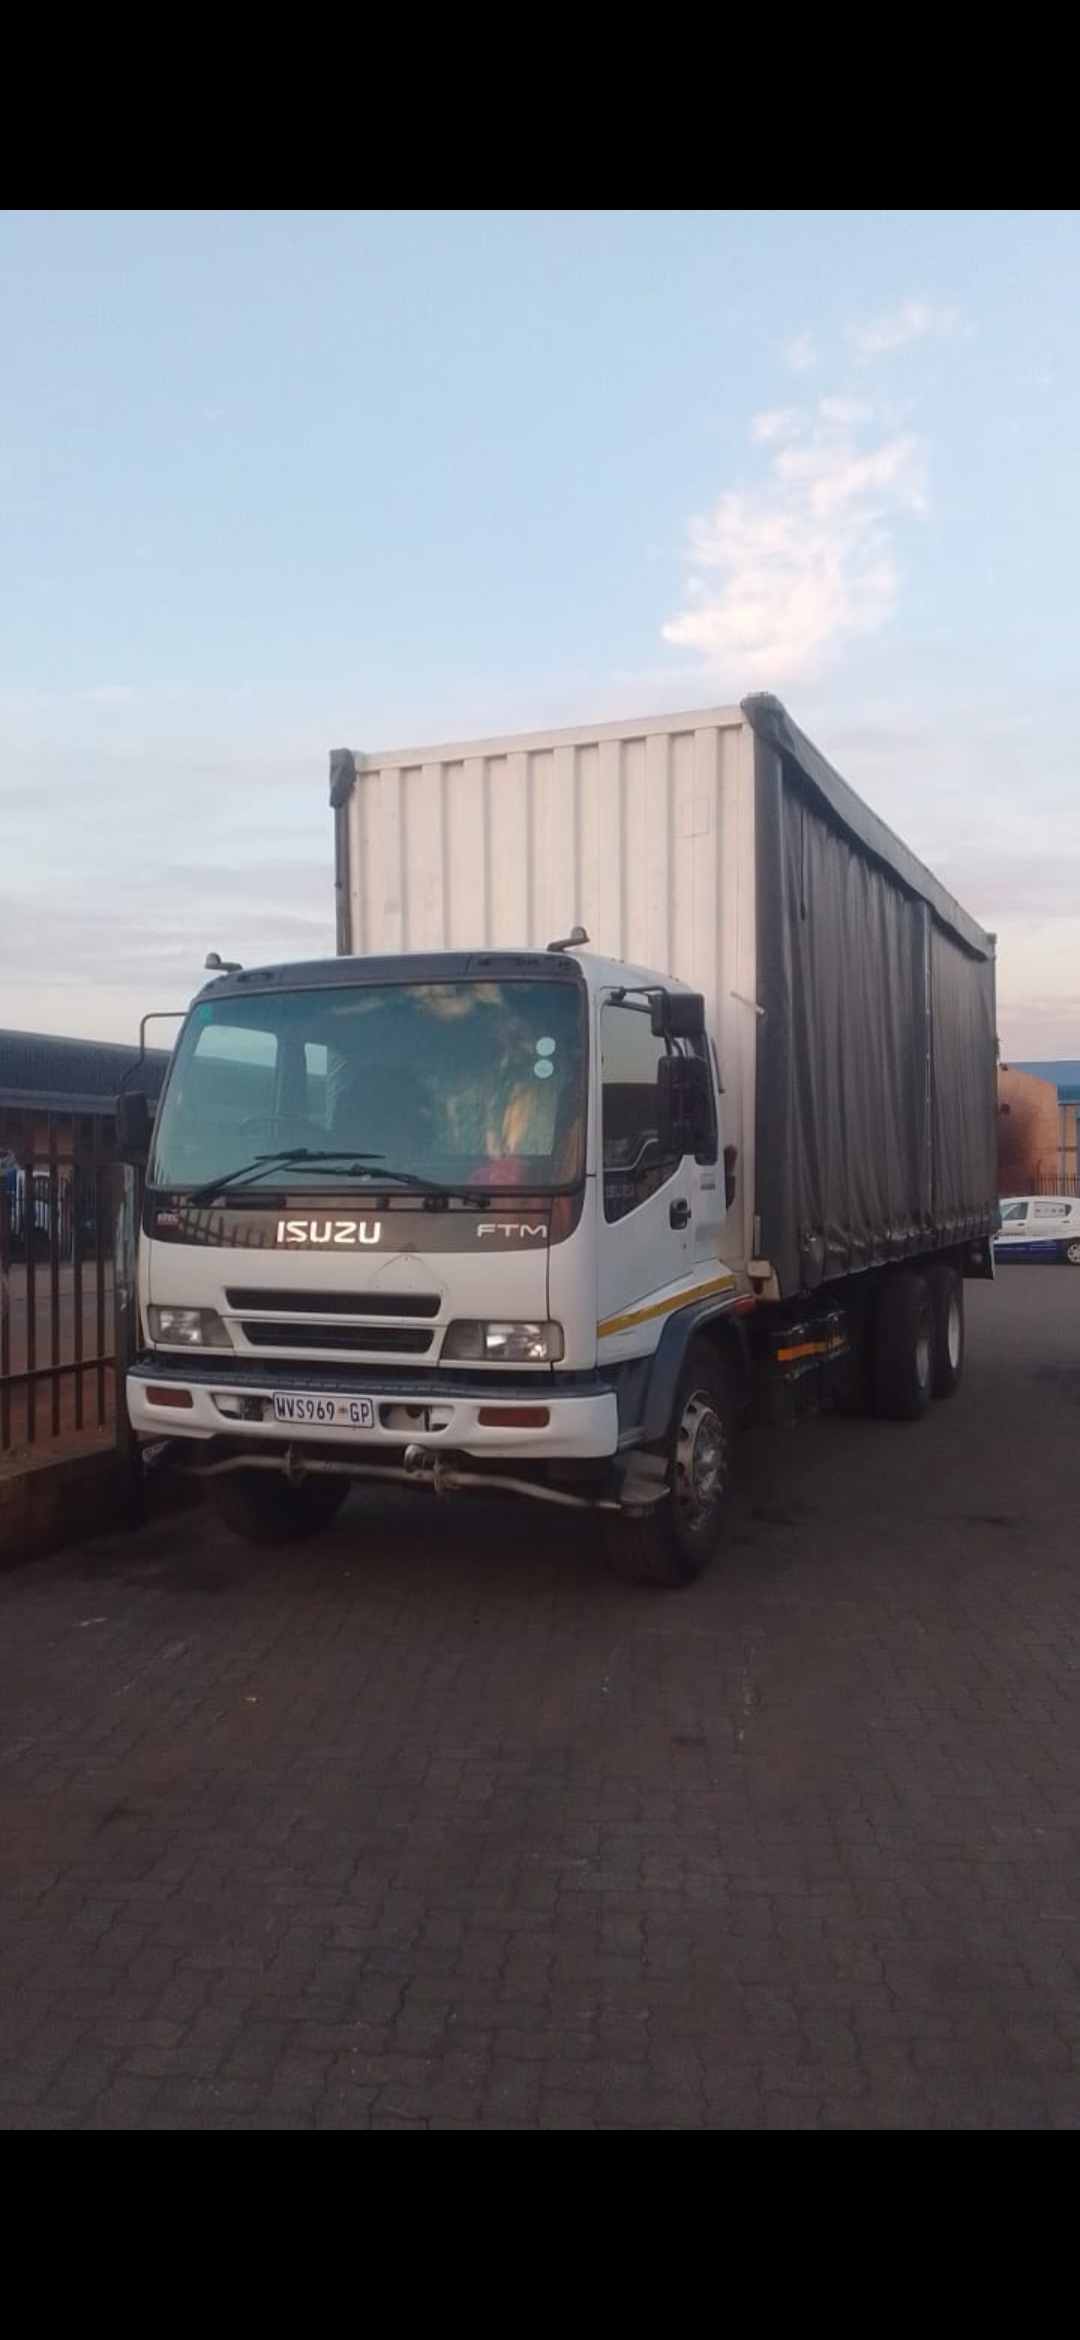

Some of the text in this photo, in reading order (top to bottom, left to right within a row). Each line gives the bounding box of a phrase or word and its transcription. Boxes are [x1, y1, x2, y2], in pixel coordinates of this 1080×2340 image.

[277, 1221, 381, 1244] ISUZU
[477, 1223, 547, 1238] FTM
[275, 1397, 370, 1423] WVS969 GP
